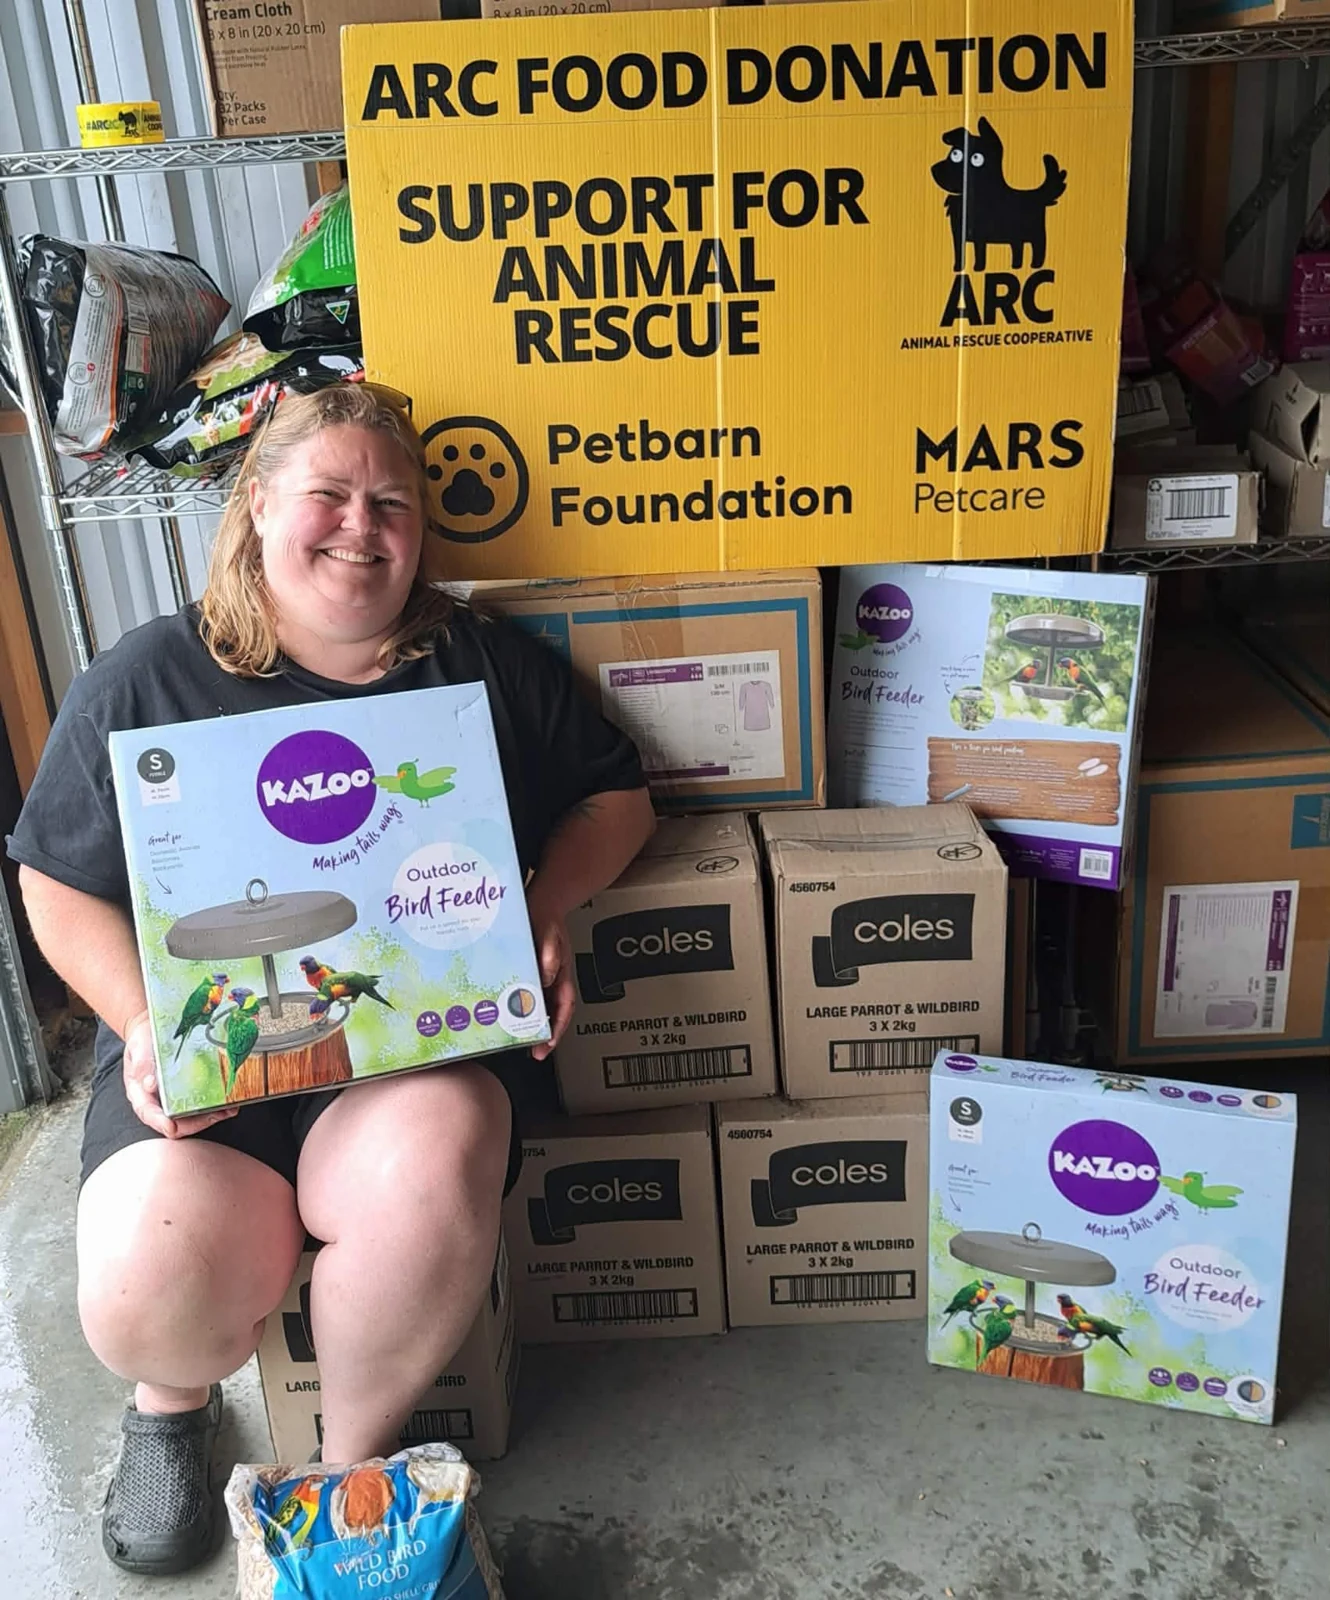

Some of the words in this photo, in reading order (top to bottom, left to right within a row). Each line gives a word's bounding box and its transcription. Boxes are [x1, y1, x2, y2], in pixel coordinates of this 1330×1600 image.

[205, 7, 251, 21] Cream
[255, 1, 293, 18] Cloth
[525, 7, 535, 17] in
[538, 4, 553, 17] (20
[561, 6, 569, 14] x
[571, 3, 586, 14] 20
[590, 0, 611, 13] cm)
[218, 32, 226, 40] x
[228, 27, 236, 39] 8
[240, 28, 250, 38] in
[253, 25, 272, 39] (20
[286, 23, 300, 36] 20
[303, 20, 326, 35] cm)
[361, 59, 498, 121] ARC
[516, 51, 708, 115] FOOD
[726, 32, 1107, 106] DONATION
[234, 100, 266, 113] Packs
[222, 116, 239, 126] Per
[241, 114, 267, 125] Case
[397, 173, 714, 244] SUPPORT
[732, 168, 870, 230] FOR
[492, 236, 775, 304] ANIMAL
[940, 269, 1055, 328] ARC
[514, 300, 760, 365] RESCUE
[901, 335, 951, 350] ANIMAL
[953, 333, 1001, 348] RESCUE
[1003, 329, 1093, 346] COOPERATIVE
[547, 419, 761, 466] Petbarn
[915, 419, 1085, 474] MARS
[551, 476, 853, 527] Foundation
[914, 482, 1046, 514] Petcare
[859, 605, 911, 620] KAZOO
[850, 666, 900, 679] Outdoor
[842, 680, 875, 705] Bird
[875, 683, 925, 709] Feeder
[149, 753, 163, 770] S
[261, 768, 371, 807] KAZOO
[148, 831, 170, 846] Great
[312, 849, 361, 872] Making
[355, 830, 381, 854] tails
[407, 859, 478, 883] Outdoor
[384, 886, 434, 924] Bird
[436, 876, 508, 914] Feeder
[789, 881, 836, 894] 4560754
[854, 913, 955, 944] coles
[616, 926, 714, 958] coles
[806, 1006, 848, 1019] LARGE
[850, 1003, 901, 1017] PARROT
[904, 1003, 914, 1014] &
[916, 1000, 980, 1015] WILDBIRD
[576, 1021, 618, 1036] LARGE
[620, 1017, 670, 1032] PARROT
[673, 1015, 682, 1027] &
[683, 1010, 747, 1027] WILDBIRD
[869, 1020, 878, 1032] 3
[880, 1020, 890, 1031] X
[892, 1018, 916, 1033] 2kg
[640, 1034, 649, 1046] 3
[650, 1034, 661, 1046] X
[663, 1032, 686, 1048] 2kg
[960, 1101, 972, 1115] S
[791, 1159, 888, 1187] coles
[1053, 1149, 1157, 1182] KAZOO
[567, 1177, 662, 1204] coles
[1084, 1221, 1130, 1241] Making
[1131, 1214, 1154, 1234] tails
[746, 1243, 787, 1256] LARGE
[789, 1241, 839, 1254] PARROT
[841, 1240, 851, 1252] &
[853, 1237, 915, 1251] WILDBIRD
[527, 1260, 567, 1274] LARGE
[569, 1259, 618, 1273] PARROT
[621, 1258, 630, 1270] &
[632, 1256, 694, 1270] WILDBIRD
[808, 1256, 816, 1267] 3
[818, 1256, 828, 1267] X
[830, 1255, 854, 1269] 2kg
[1169, 1257, 1243, 1280] Outdoor
[589, 1275, 597, 1286] 3
[599, 1275, 609, 1286] X
[611, 1273, 635, 1288] 2kg
[1144, 1272, 1190, 1304] Bird
[1191, 1281, 1267, 1312] Feeder
[286, 1379, 321, 1394] LARG
[433, 1374, 467, 1388] BIRD
[333, 1552, 382, 1578] WILD
[386, 1539, 427, 1566] BIRD
[358, 1563, 410, 1591] FOOD
